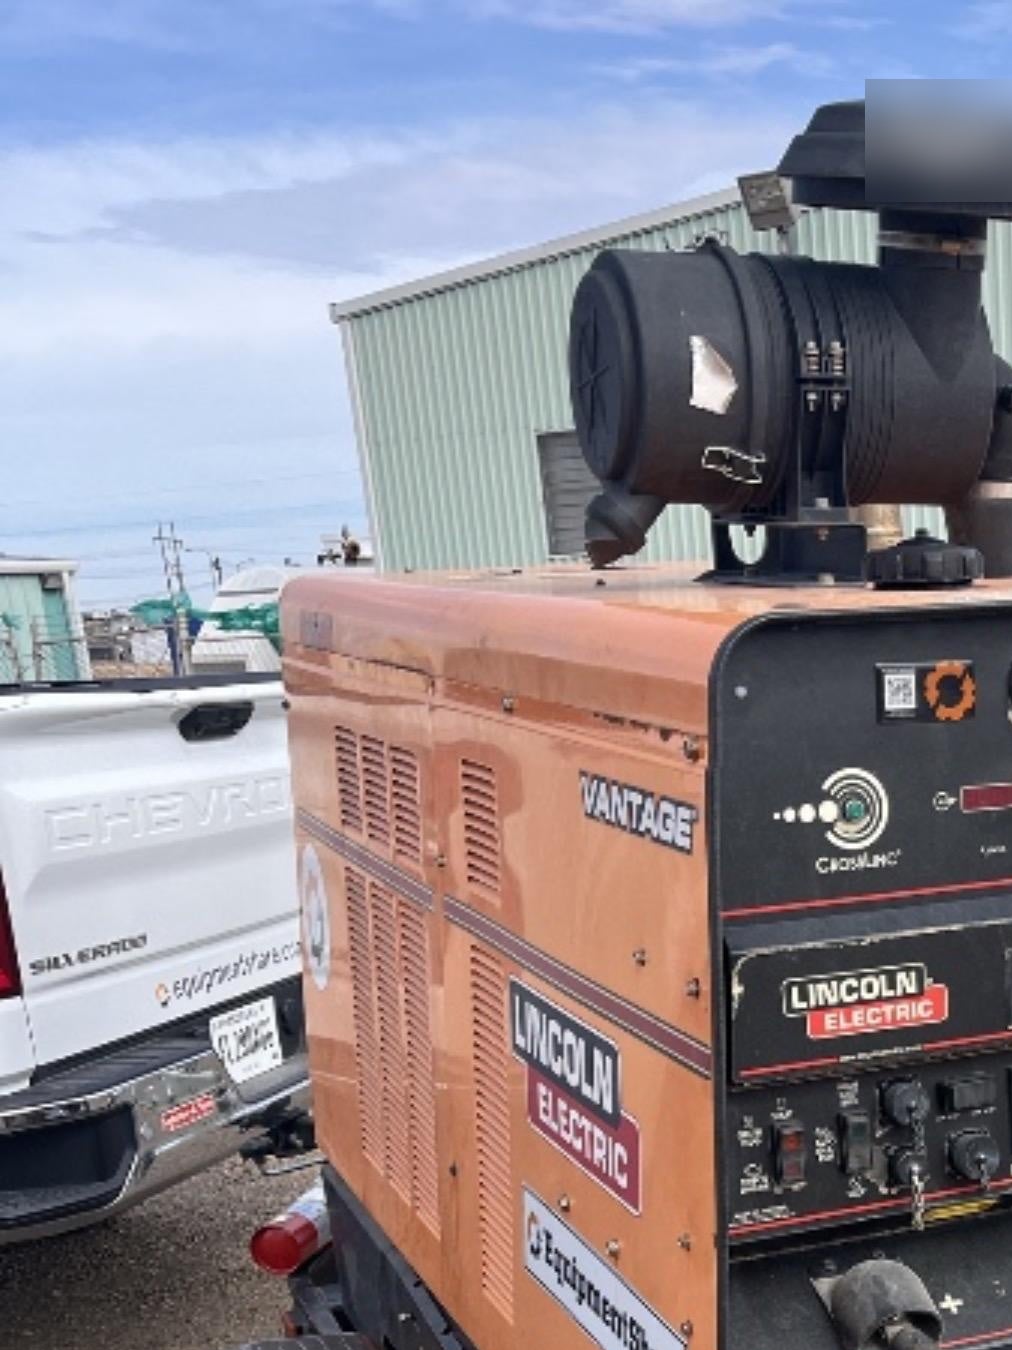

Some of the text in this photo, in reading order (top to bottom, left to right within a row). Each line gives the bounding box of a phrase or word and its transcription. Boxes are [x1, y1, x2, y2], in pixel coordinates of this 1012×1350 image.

[44, 775, 290, 851] CHEVRO
[581, 773, 692, 850] VANTAGE
[28, 932, 148, 976] SILVERADO
[791, 971, 918, 1010] LINCOLN
[823, 999, 935, 1032] ELECTRIC
[513, 993, 614, 1115] LINCOLN
[538, 1081, 629, 1190] ELECTRIC
